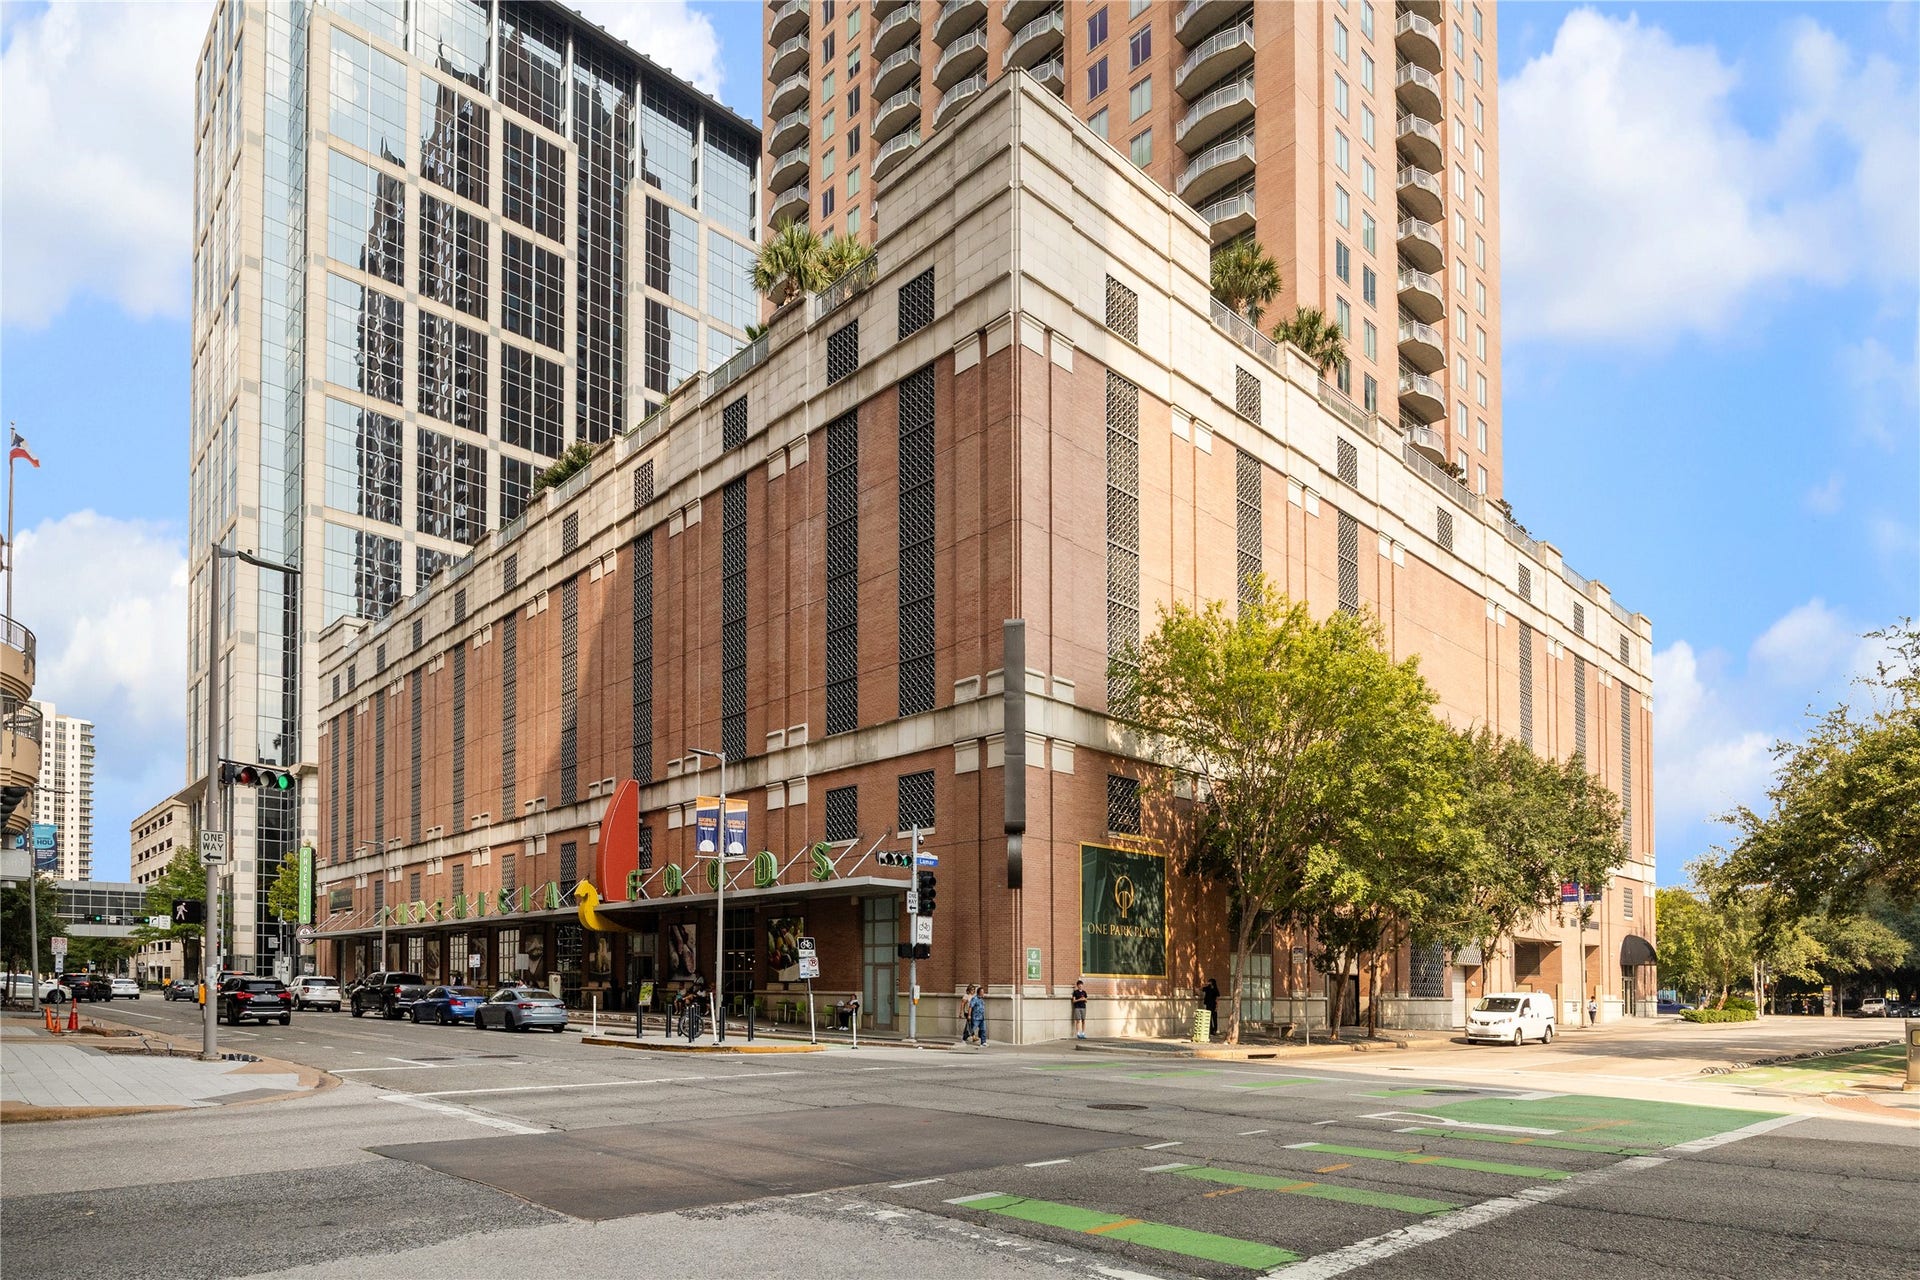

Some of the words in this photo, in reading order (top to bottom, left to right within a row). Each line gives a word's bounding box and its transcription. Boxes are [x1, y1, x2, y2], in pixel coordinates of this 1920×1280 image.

[203, 832, 224, 842] ONE
[203, 842, 224, 851] WAY
[625, 841, 836, 901] FOODS
[1087, 922, 1108, 935] ONE
[1110, 924, 1133, 937] PARK
[1134, 926, 1160, 938] PLACE
